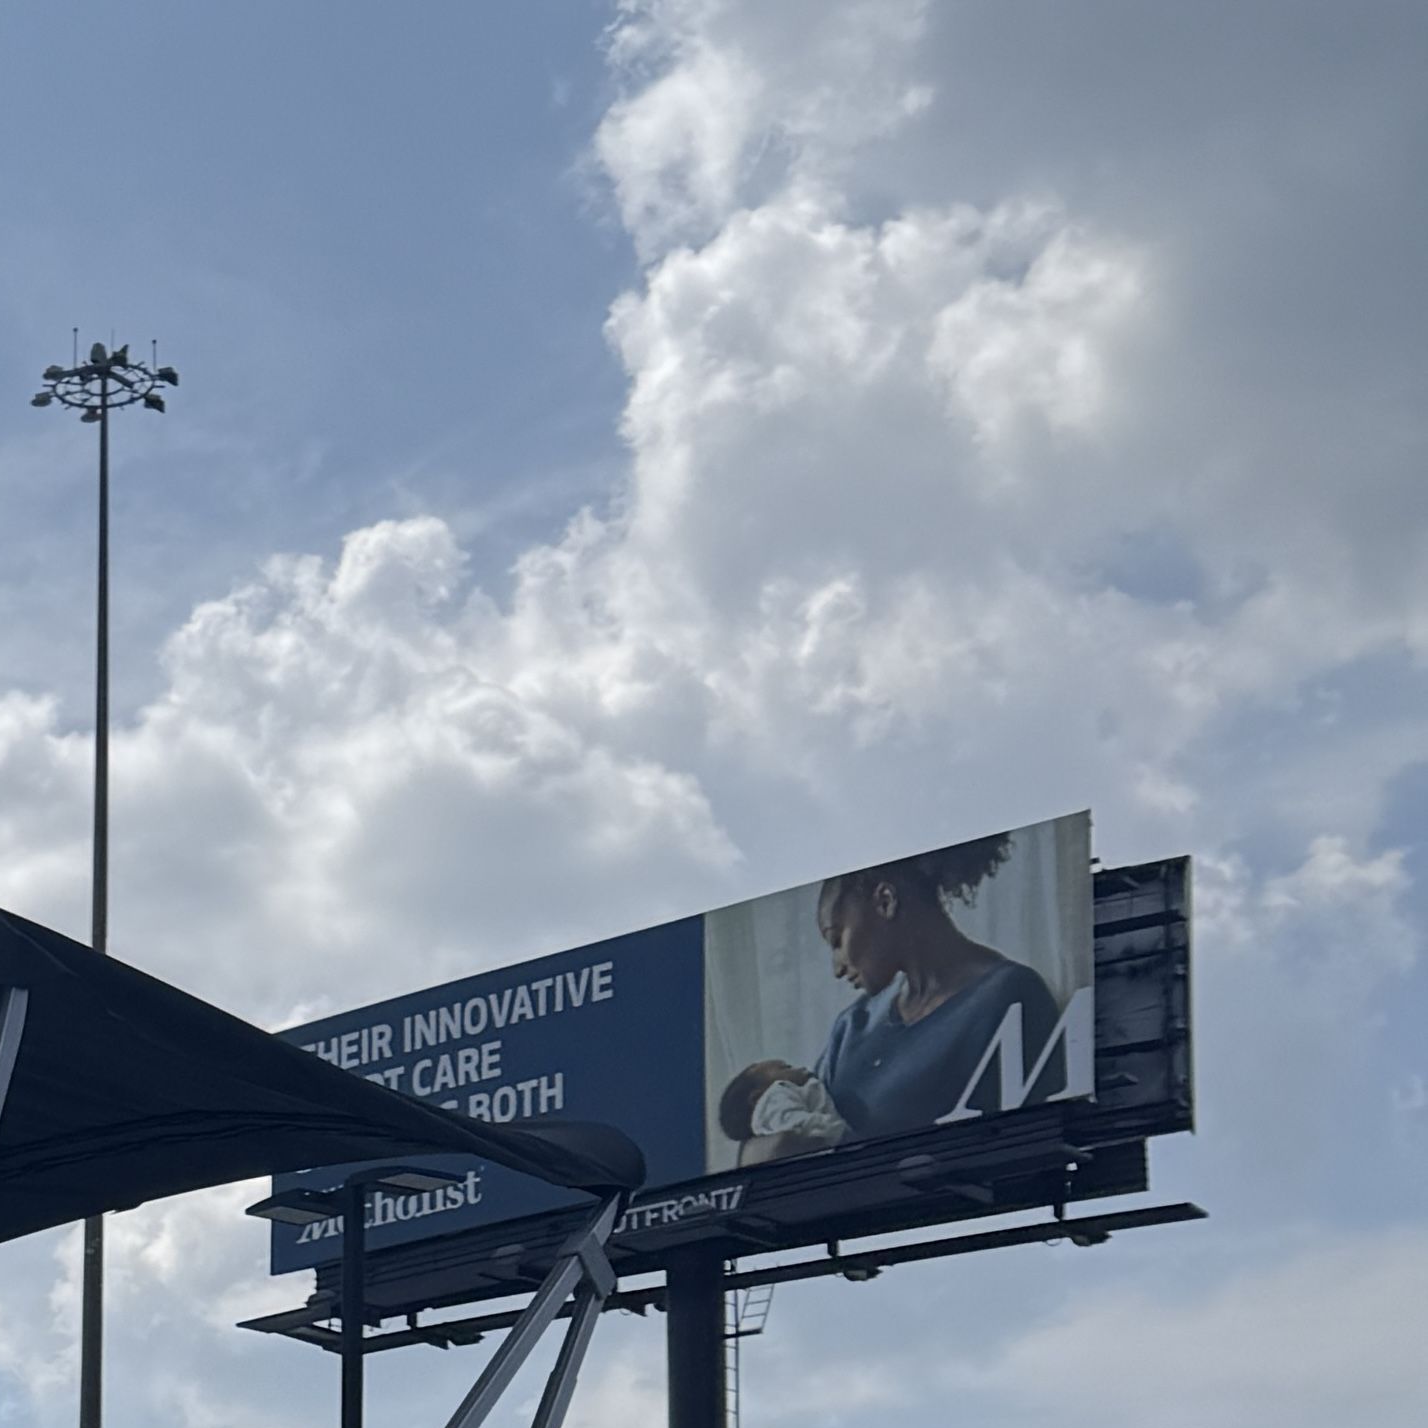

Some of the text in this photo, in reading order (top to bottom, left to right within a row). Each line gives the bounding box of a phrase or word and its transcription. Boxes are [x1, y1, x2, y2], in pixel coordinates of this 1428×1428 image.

[403, 961, 614, 1053] INNOVATIVE
[411, 1040, 503, 1097] CARE
[468, 1072, 565, 1124] BOTH
